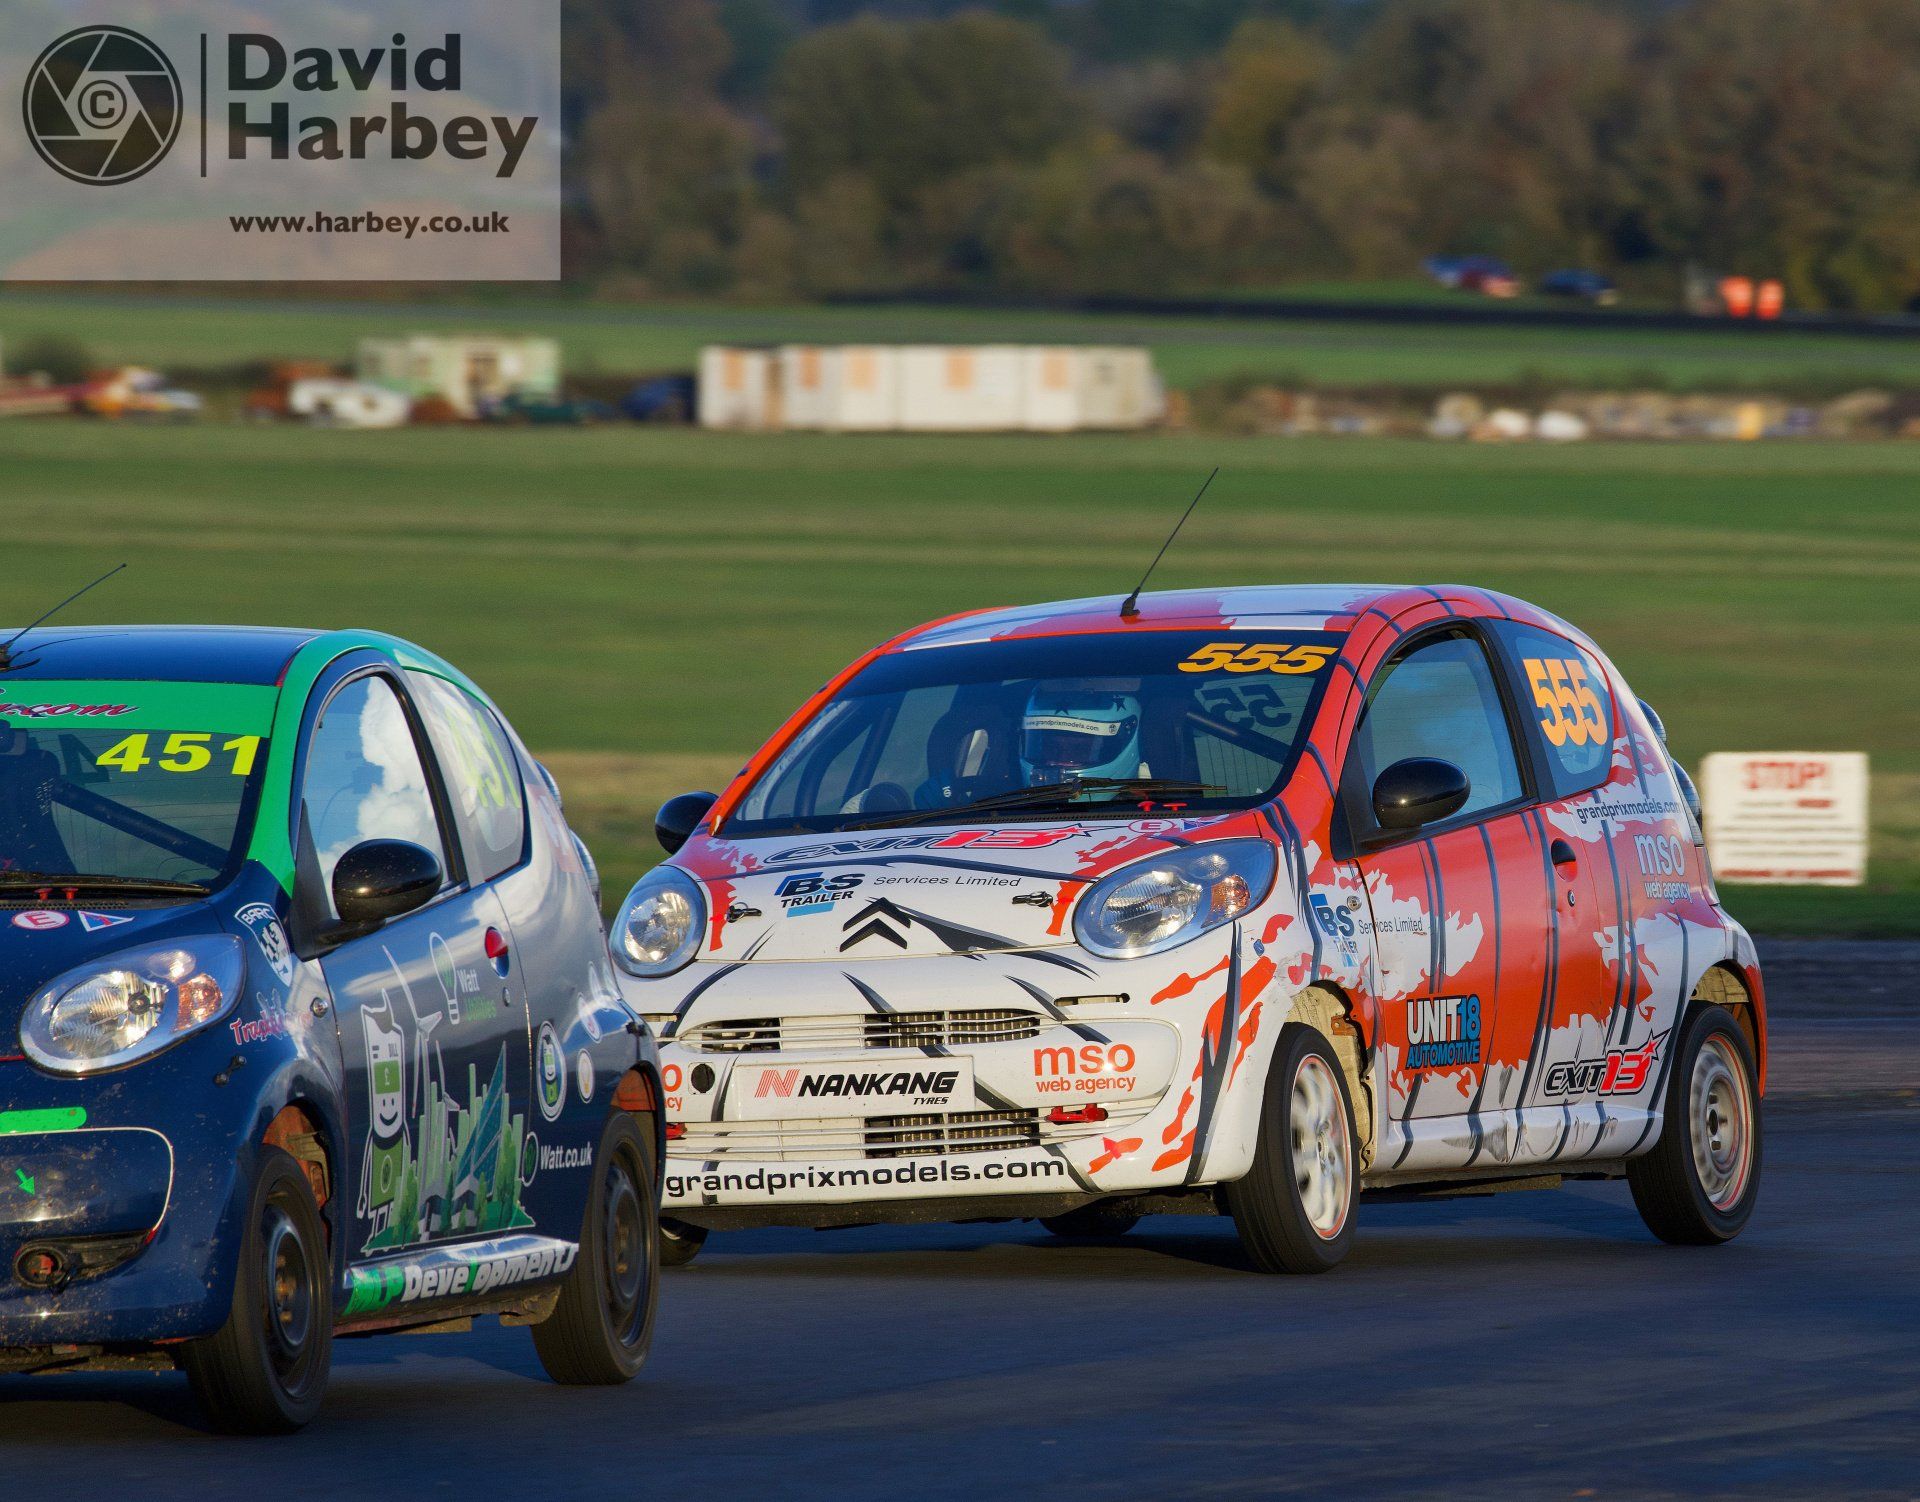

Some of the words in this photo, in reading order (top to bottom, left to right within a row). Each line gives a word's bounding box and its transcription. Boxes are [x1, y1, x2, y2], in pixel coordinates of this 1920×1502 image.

[1177, 642, 1340, 674] 555
[1523, 659, 1609, 747] 555
[96, 733, 261, 776] 451
[1634, 834, 1685, 876] mso
[780, 872, 866, 897] BS
[873, 874, 950, 887] Services
[955, 875, 1022, 887] Limited
[1645, 876, 1661, 899] web
[1663, 881, 1692, 904] agency
[781, 890, 855, 909] TRAILER
[241, 907, 276, 926] BARC
[1316, 905, 1355, 937] BS
[1395, 916, 1423, 932] Limited
[457, 969, 480, 993] Watt
[1033, 1043, 1136, 1077] mso
[1405, 1041, 1481, 1069] AUTOMOTIVE
[798, 1070, 960, 1098] NANKANG
[1036, 1077, 1072, 1093] web
[1075, 1076, 1137, 1095] agency
[913, 1096, 949, 1106] TYRES
[540, 1141, 593, 1170] Watt.co.uk
[666, 1156, 1065, 1197] grandprixmodels.com
